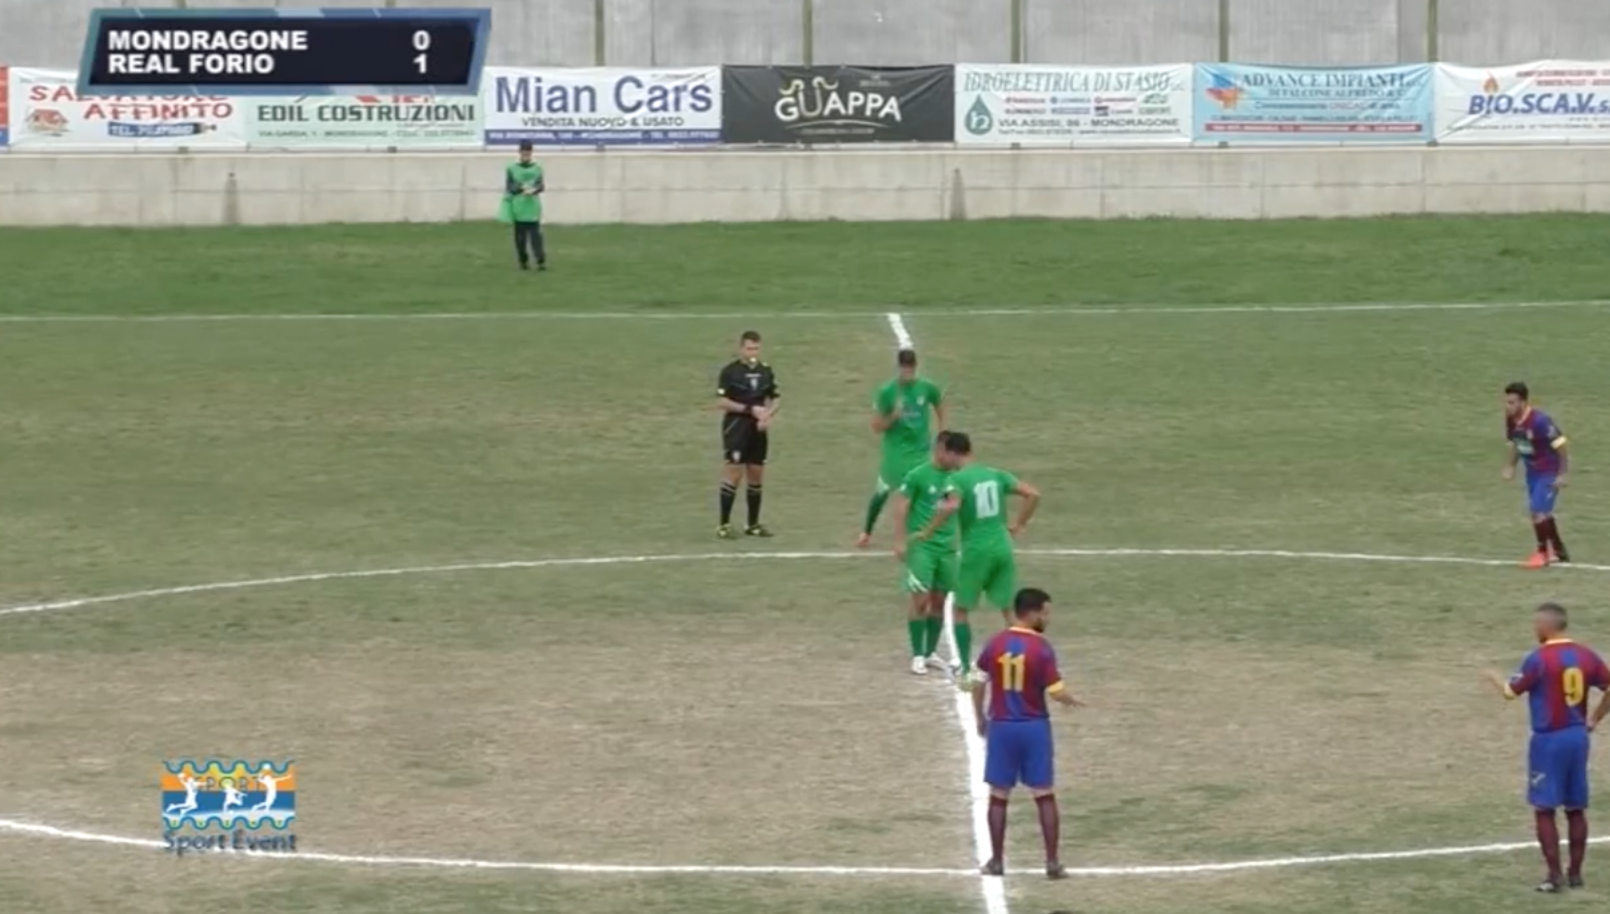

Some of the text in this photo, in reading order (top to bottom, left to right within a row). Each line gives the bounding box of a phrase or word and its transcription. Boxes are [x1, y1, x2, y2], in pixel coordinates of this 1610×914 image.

[964, 72, 1090, 92] IDROELETTRICA
[1242, 74, 1321, 87] ADVANCE
[495, 75, 713, 114] Mian Cars
[774, 76, 902, 121] GUAPPA
[84, 103, 233, 120] AFFINITO
[258, 105, 475, 122] EDIL COSTRUZIONI
[522, 116, 576, 127] VENDITA
[578, 116, 627, 127] NUOVO
[642, 116, 684, 126] USATO
[1091, 118, 1179, 127] MONDRAGONE
[974, 480, 999, 518] 10
[998, 652, 1025, 691] 11
[1563, 667, 1585, 707] 9
